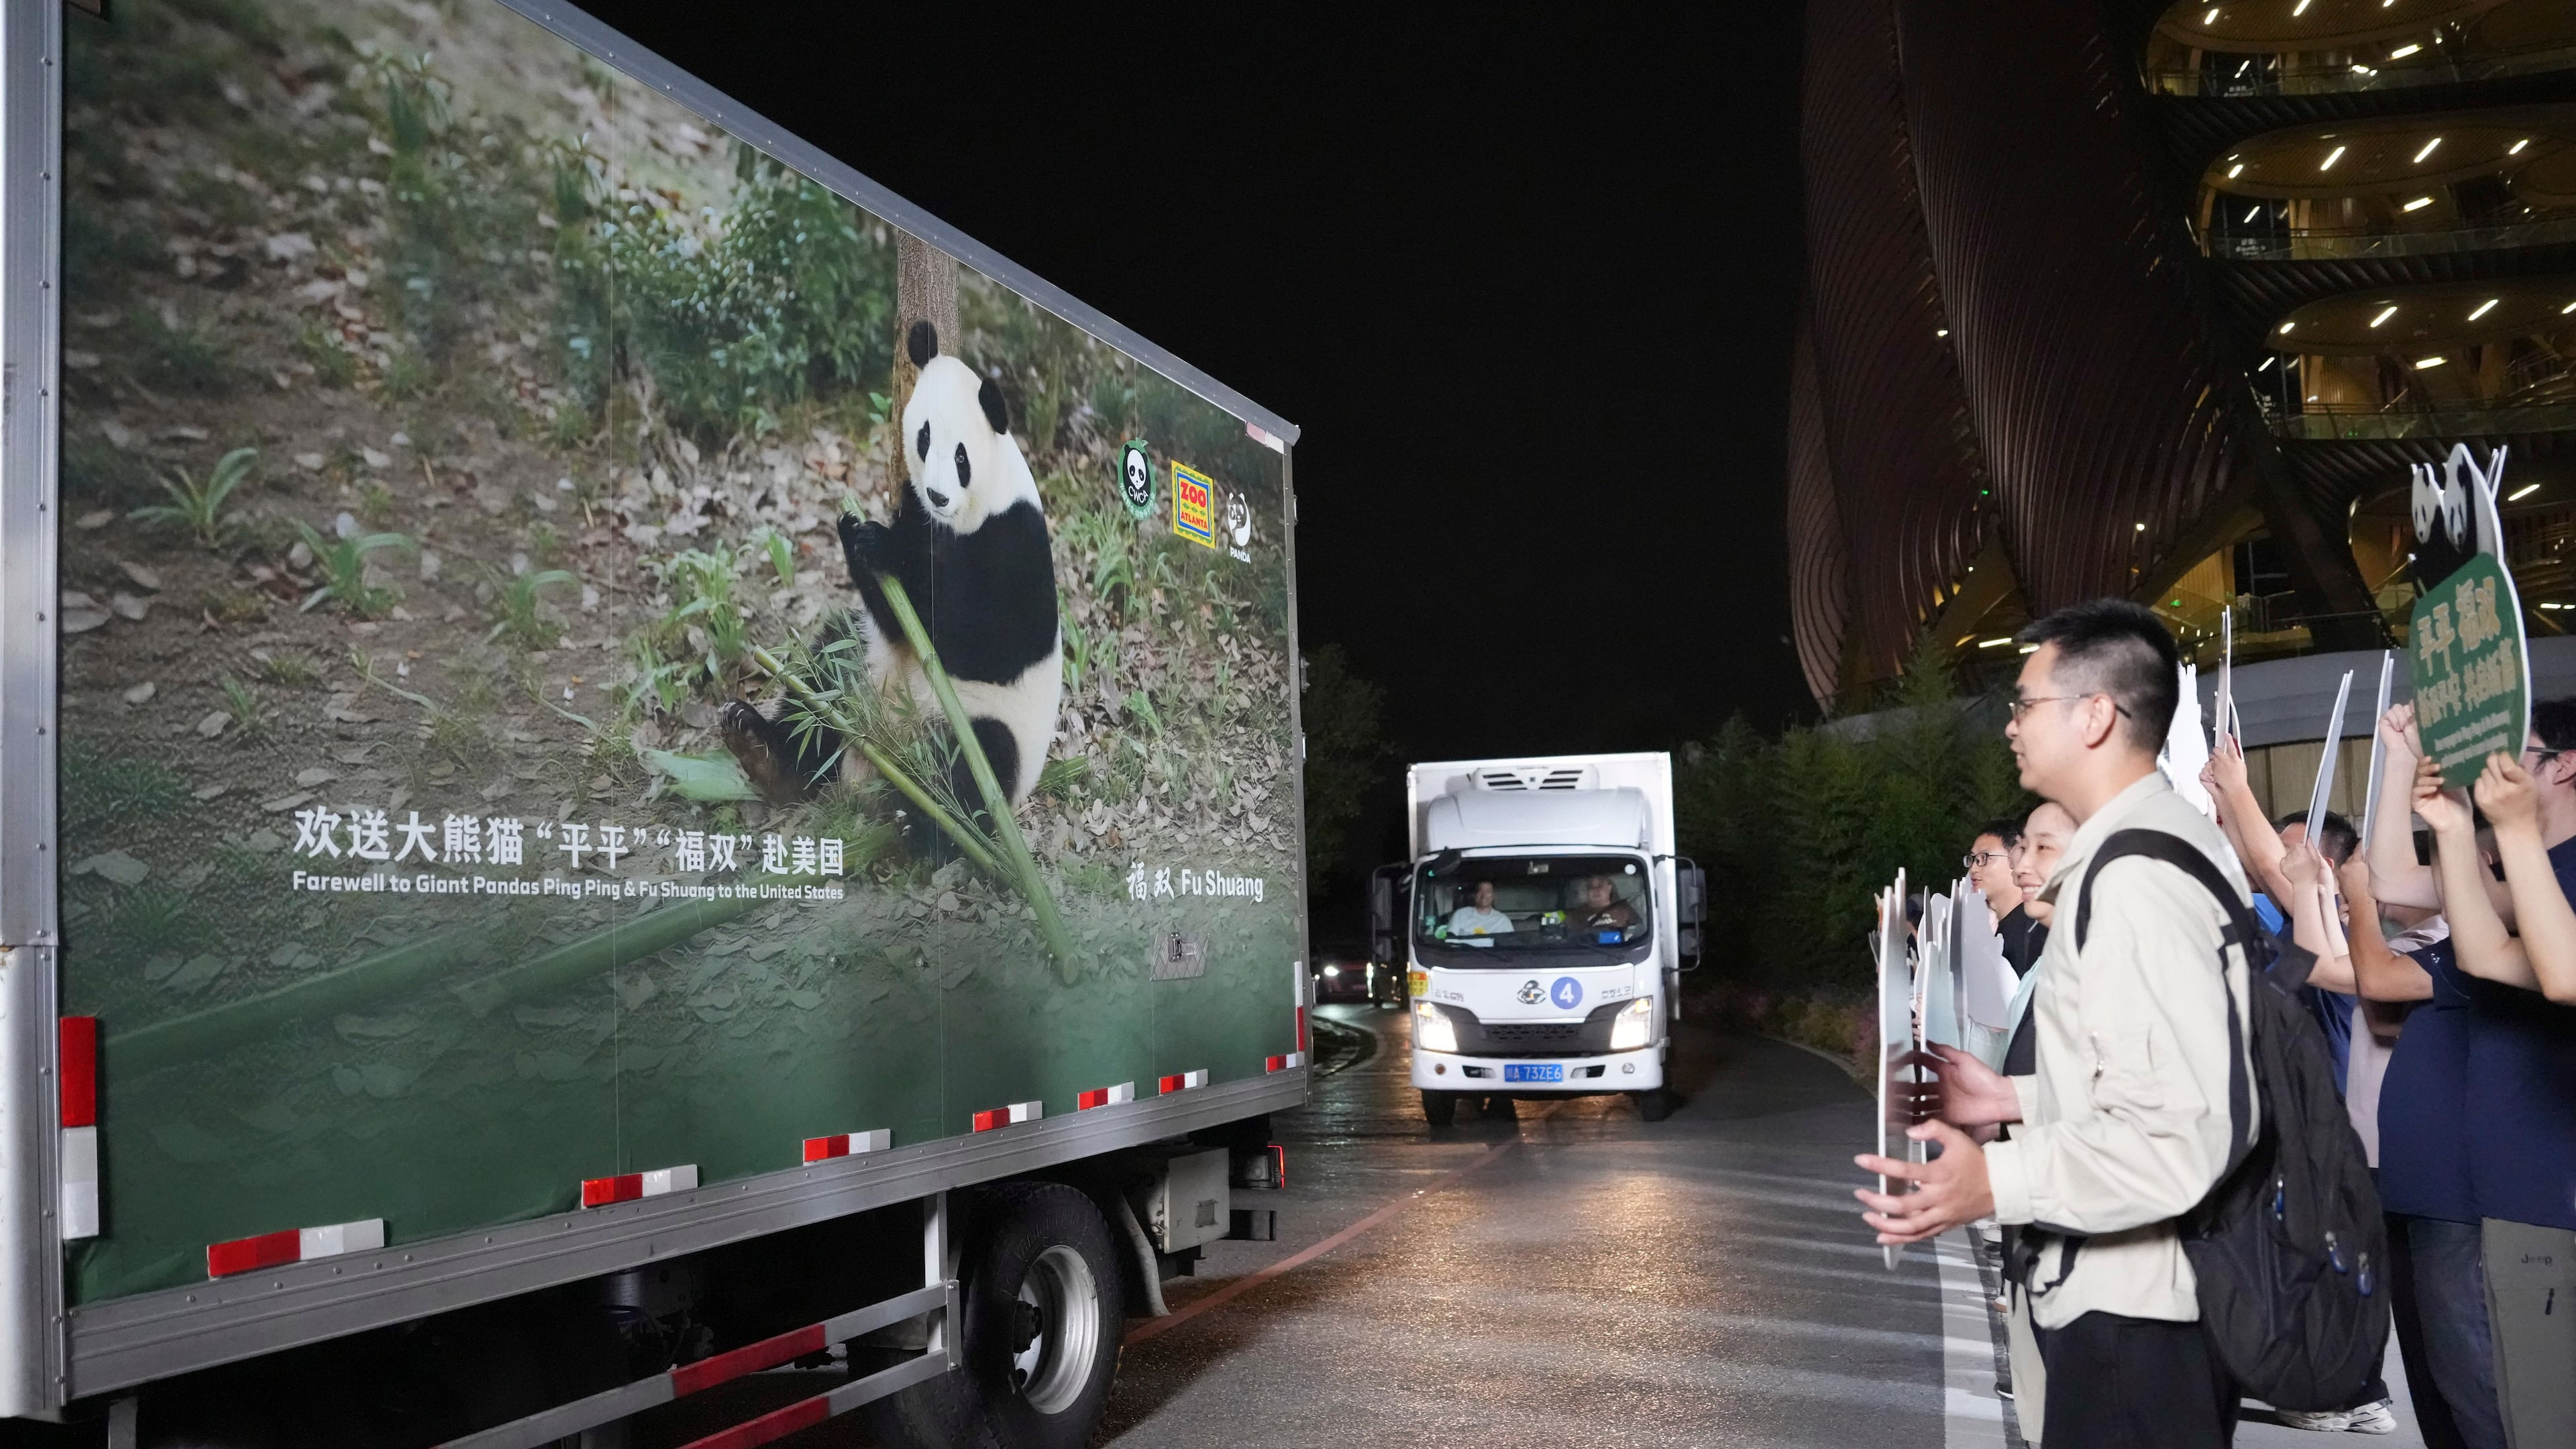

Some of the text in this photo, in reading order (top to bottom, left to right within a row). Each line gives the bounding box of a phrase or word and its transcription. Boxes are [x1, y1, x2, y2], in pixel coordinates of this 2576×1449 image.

[1128, 485, 1149, 503] CWCA
[1181, 481, 1207, 508] ZOO
[1181, 511, 1208, 530] ATLANTA
[1230, 546, 1251, 564] PANDA
[293, 871, 843, 902] Farewell to Giant Pandas Ping Ping & Fu Shuang to the United States
[1181, 869, 1263, 903] Fu Shuang
[1560, 983, 1574, 1004] 4
